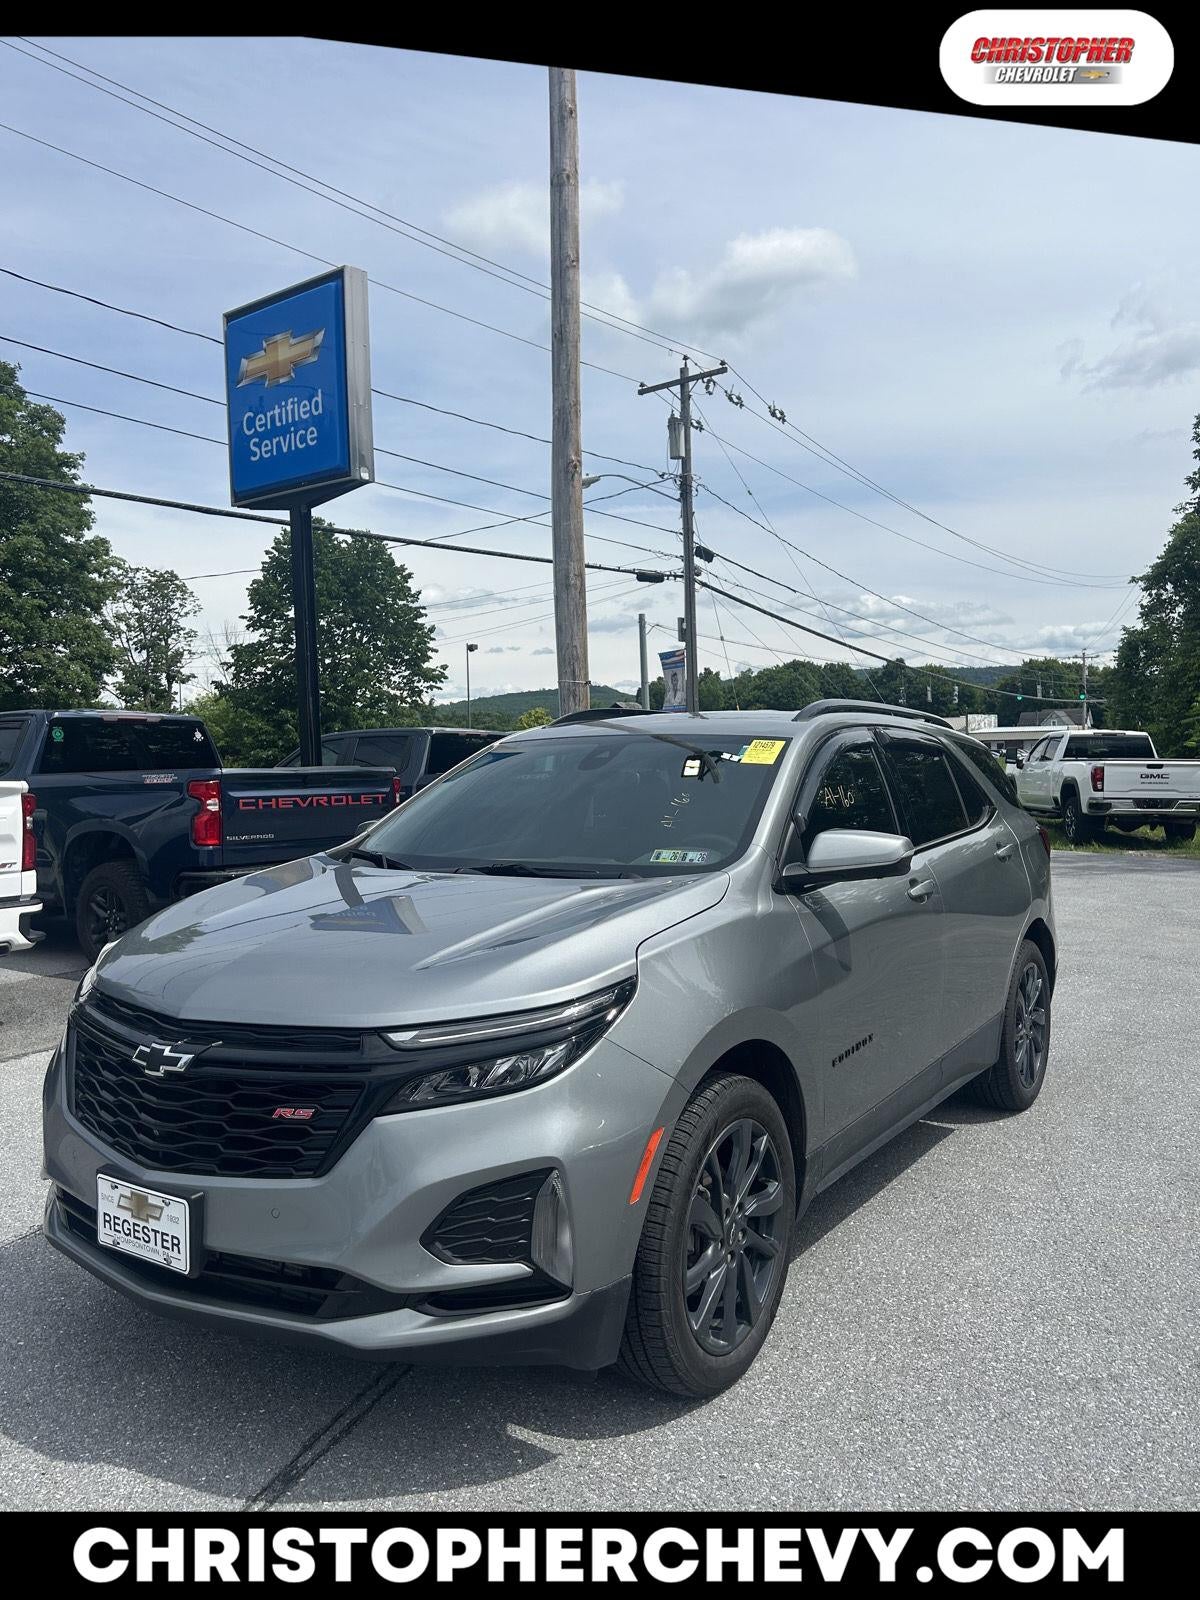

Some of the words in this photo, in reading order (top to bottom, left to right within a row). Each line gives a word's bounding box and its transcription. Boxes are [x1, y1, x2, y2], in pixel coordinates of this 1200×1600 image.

[242, 388, 323, 437] Certified
[249, 426, 319, 462] Service
[238, 794, 387, 811] CHEVROLET
[272, 1108, 315, 1119] RS
[103, 1212, 182, 1255] REGESTER
